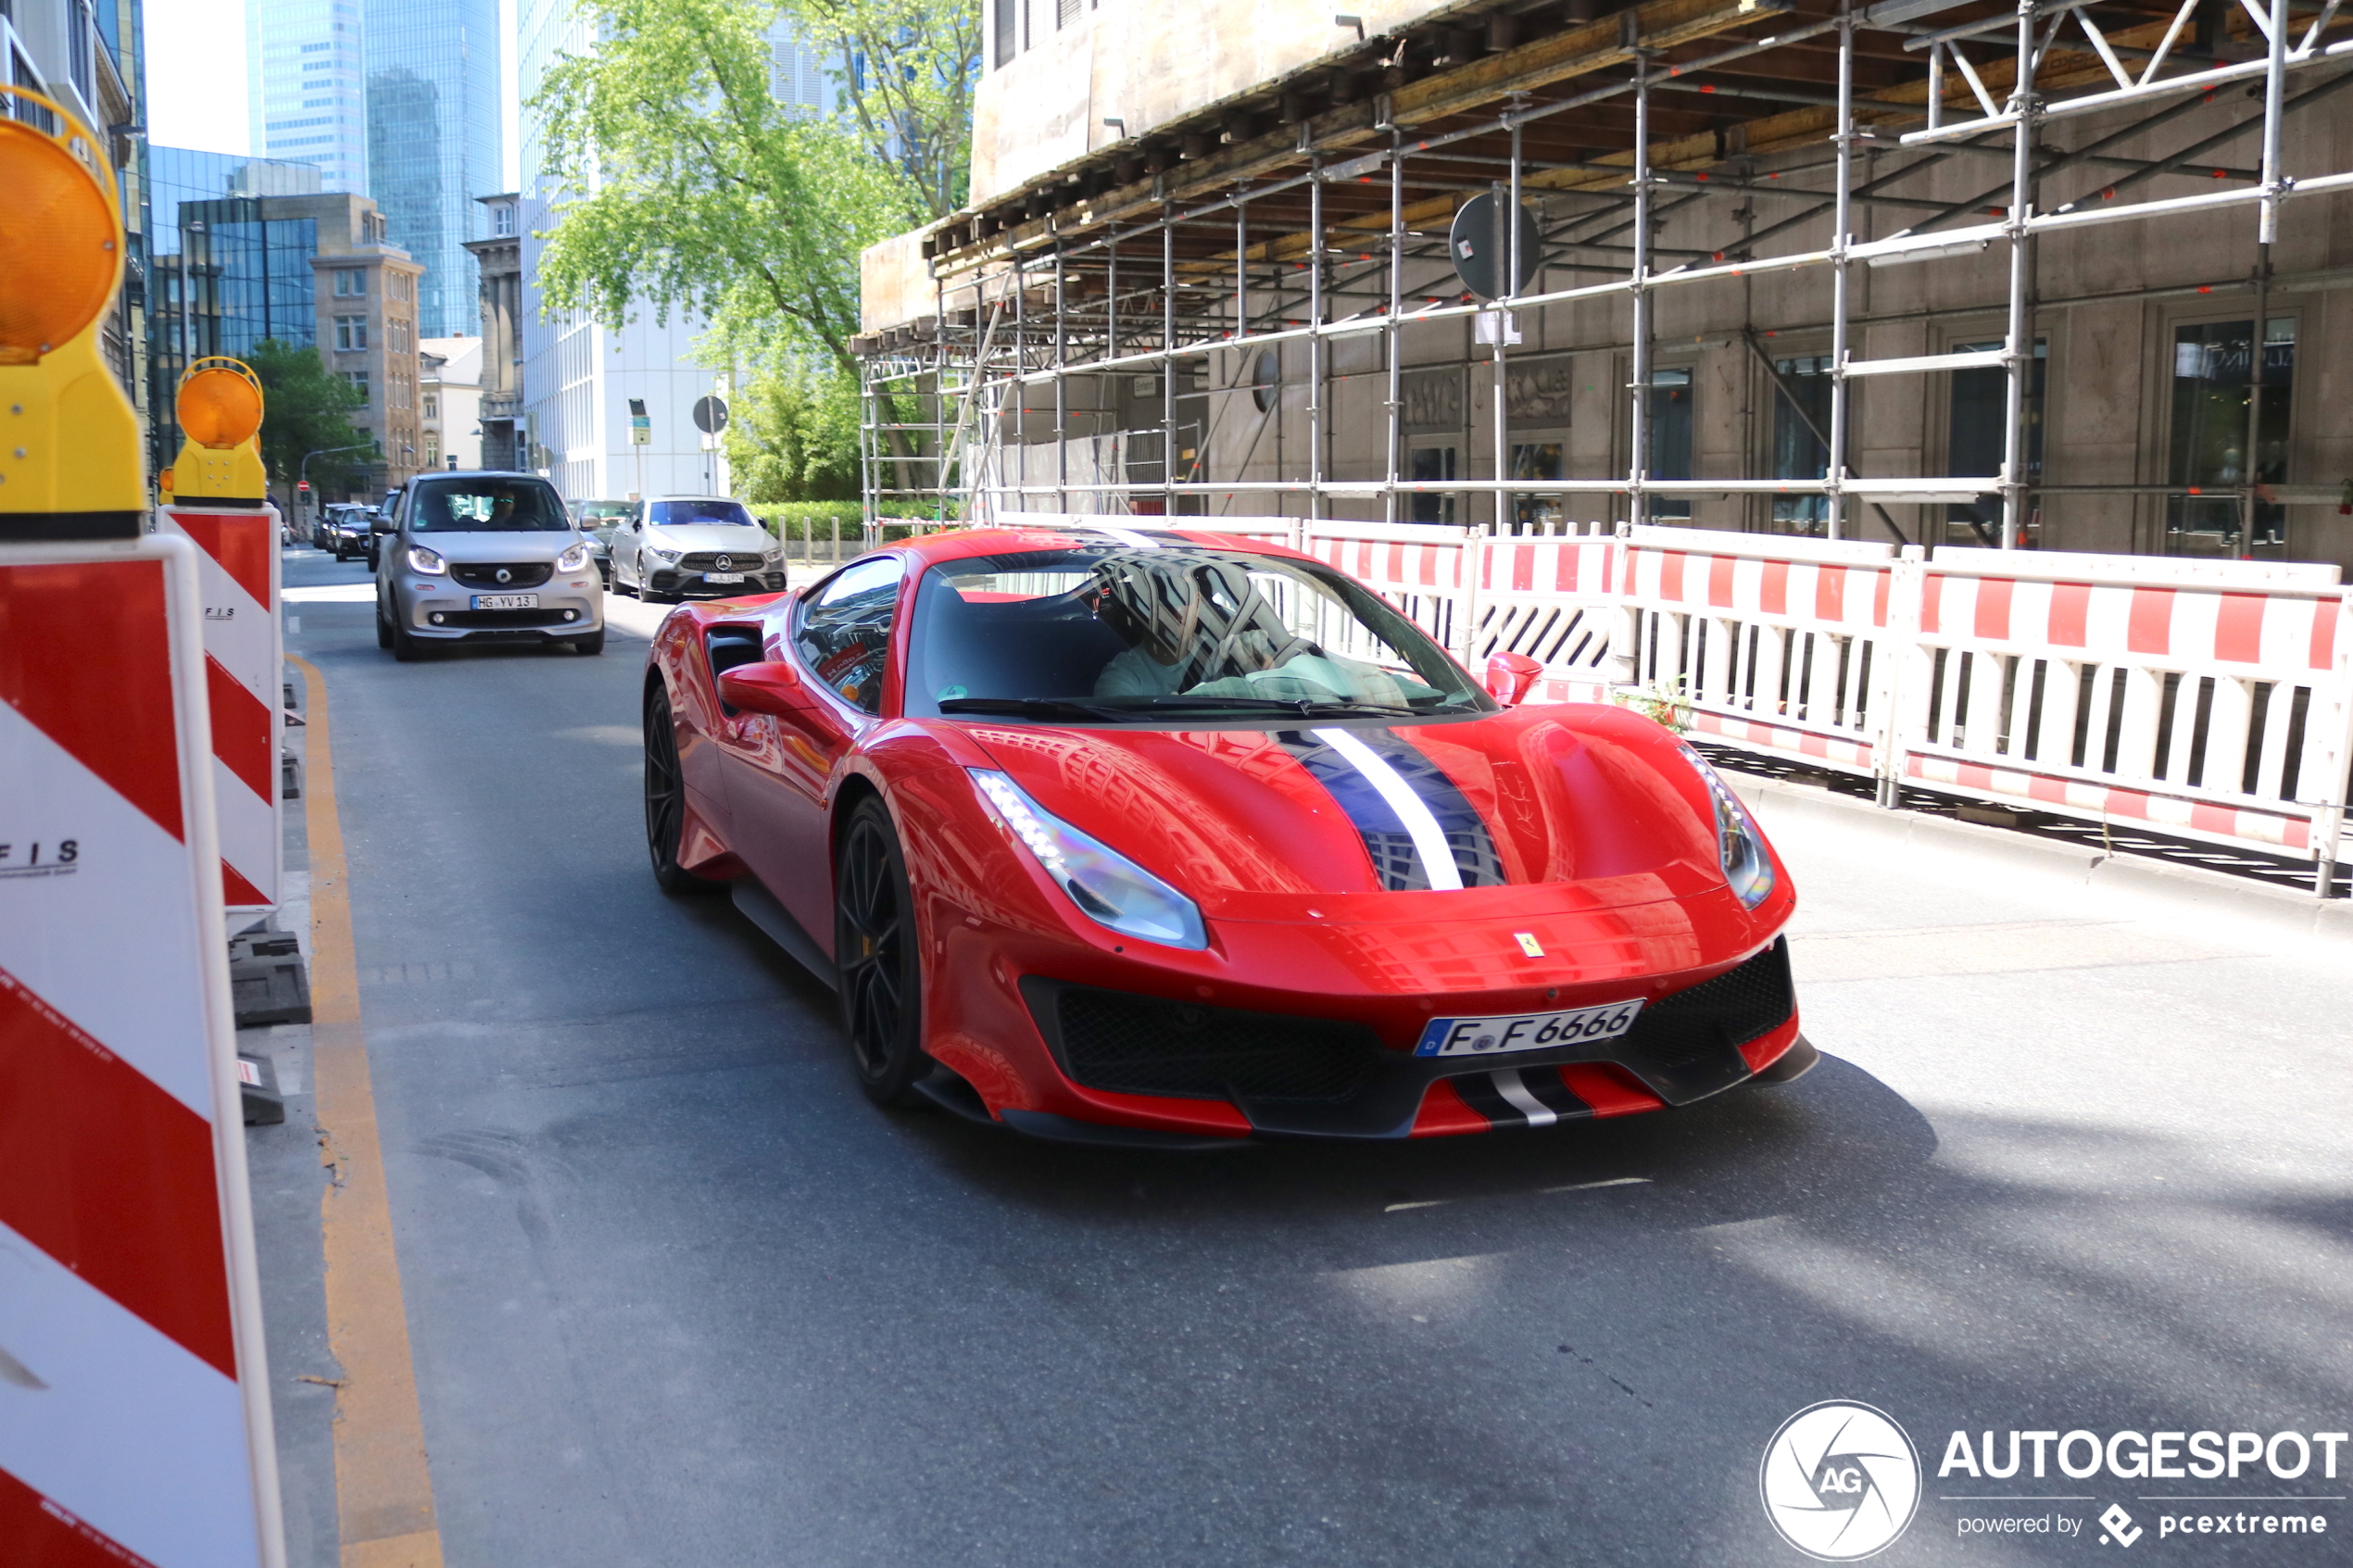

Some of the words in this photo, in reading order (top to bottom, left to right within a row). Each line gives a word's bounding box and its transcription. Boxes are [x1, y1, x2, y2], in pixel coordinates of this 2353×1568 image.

[478, 596, 493, 608] HG
[500, 596, 514, 608] YV
[516, 596, 530, 607] 13
[1444, 1022, 1481, 1052] F
[1499, 1019, 1535, 1048] F
[1535, 1006, 1631, 1045] 6666
[1425, 1041, 1437, 1050] D
